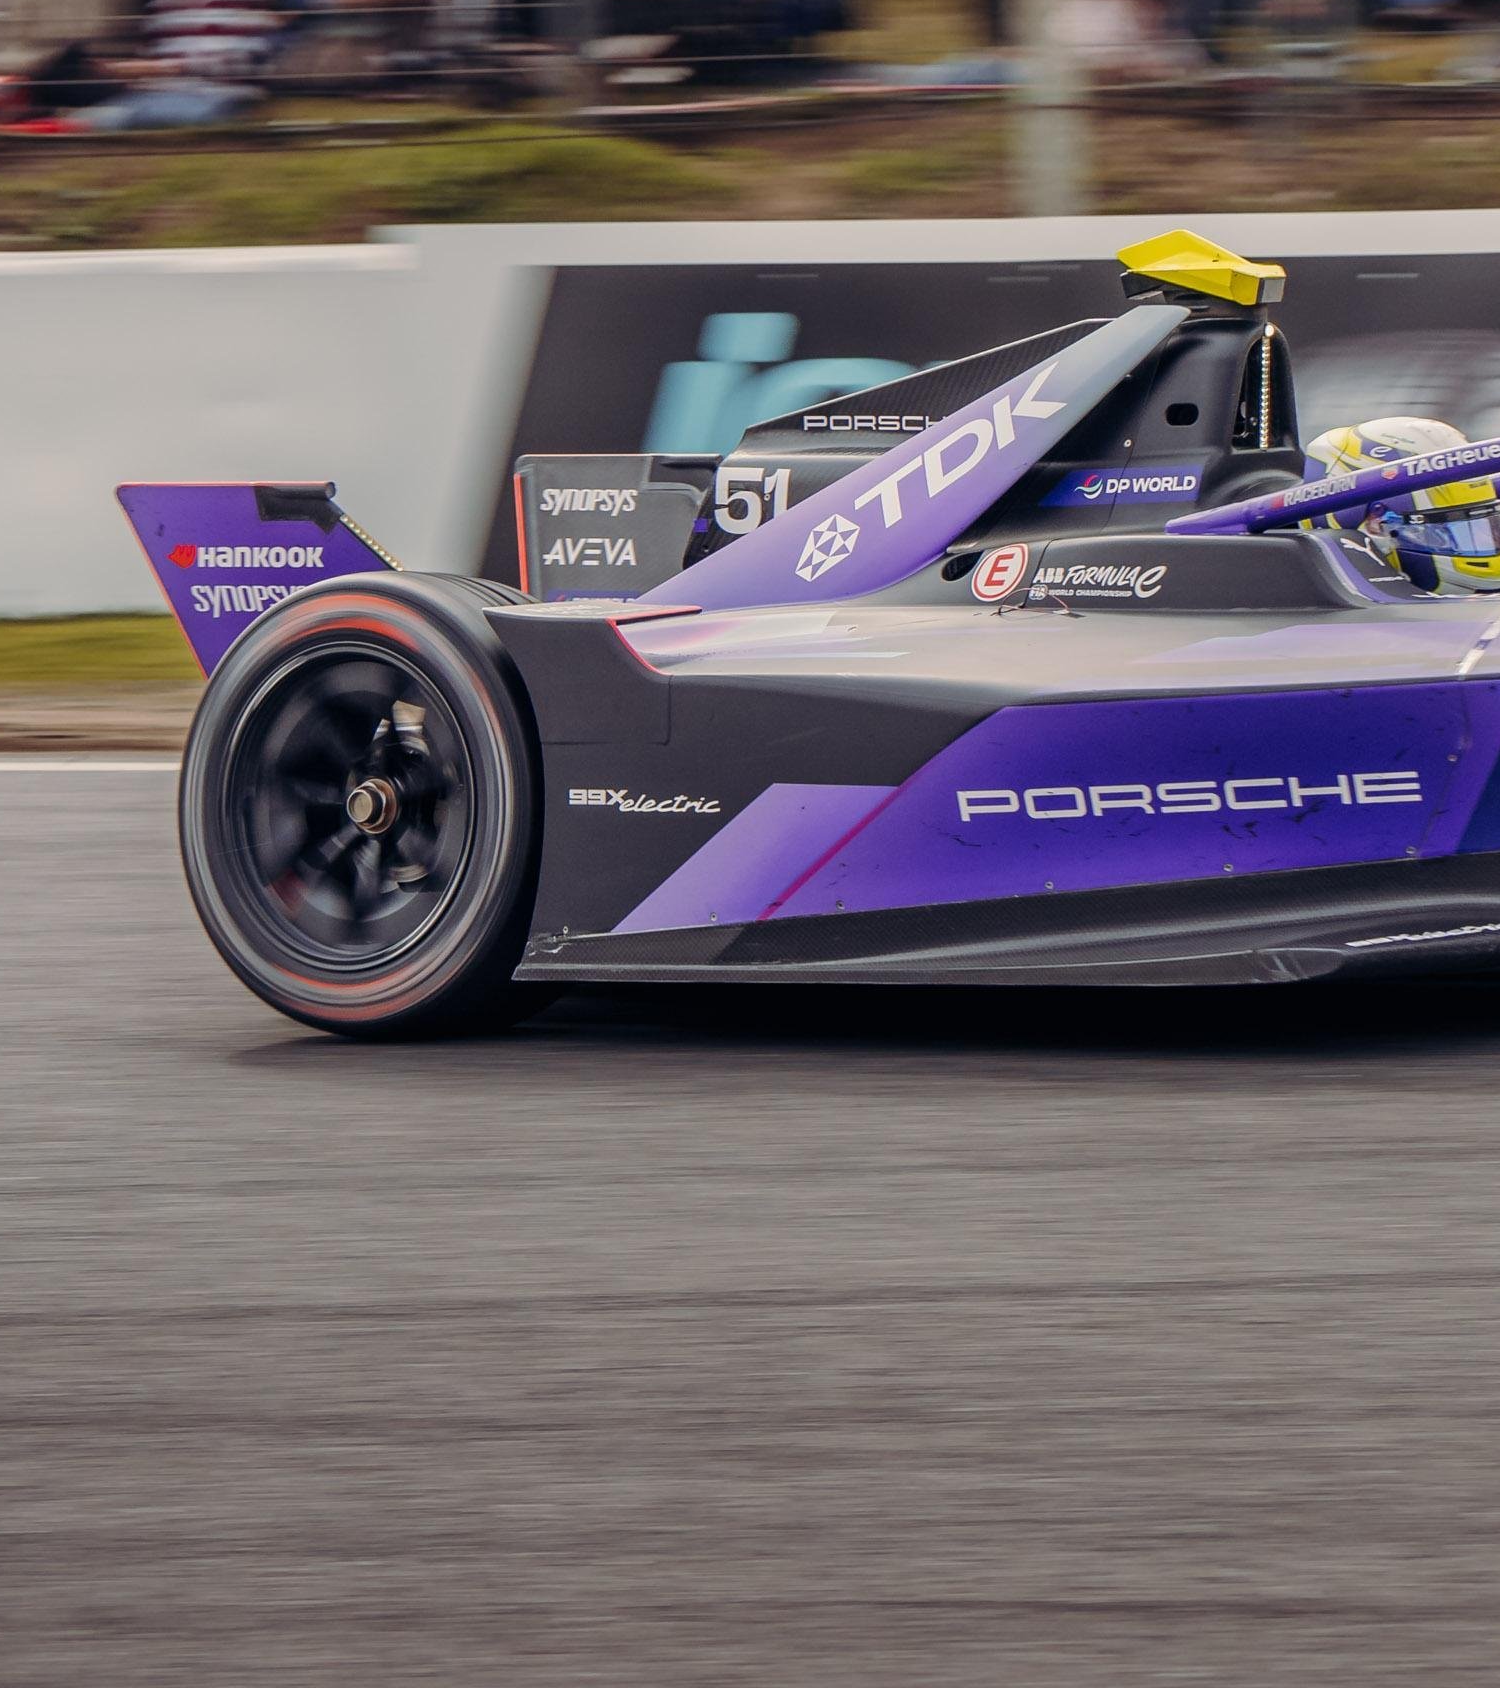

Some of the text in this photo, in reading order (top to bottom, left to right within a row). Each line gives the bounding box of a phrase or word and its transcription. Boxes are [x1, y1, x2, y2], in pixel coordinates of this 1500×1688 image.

[854, 361, 1068, 529] TDK
[714, 467, 791, 534] 51
[1106, 476, 1196, 494] DP WORLD
[543, 538, 637, 566] AVEVA
[984, 553, 1015, 587] E
[1033, 568, 1065, 583] ABB
[1075, 589, 1133, 598] CHAMPIONSHIP
[956, 771, 1423, 822] PORSCHE
